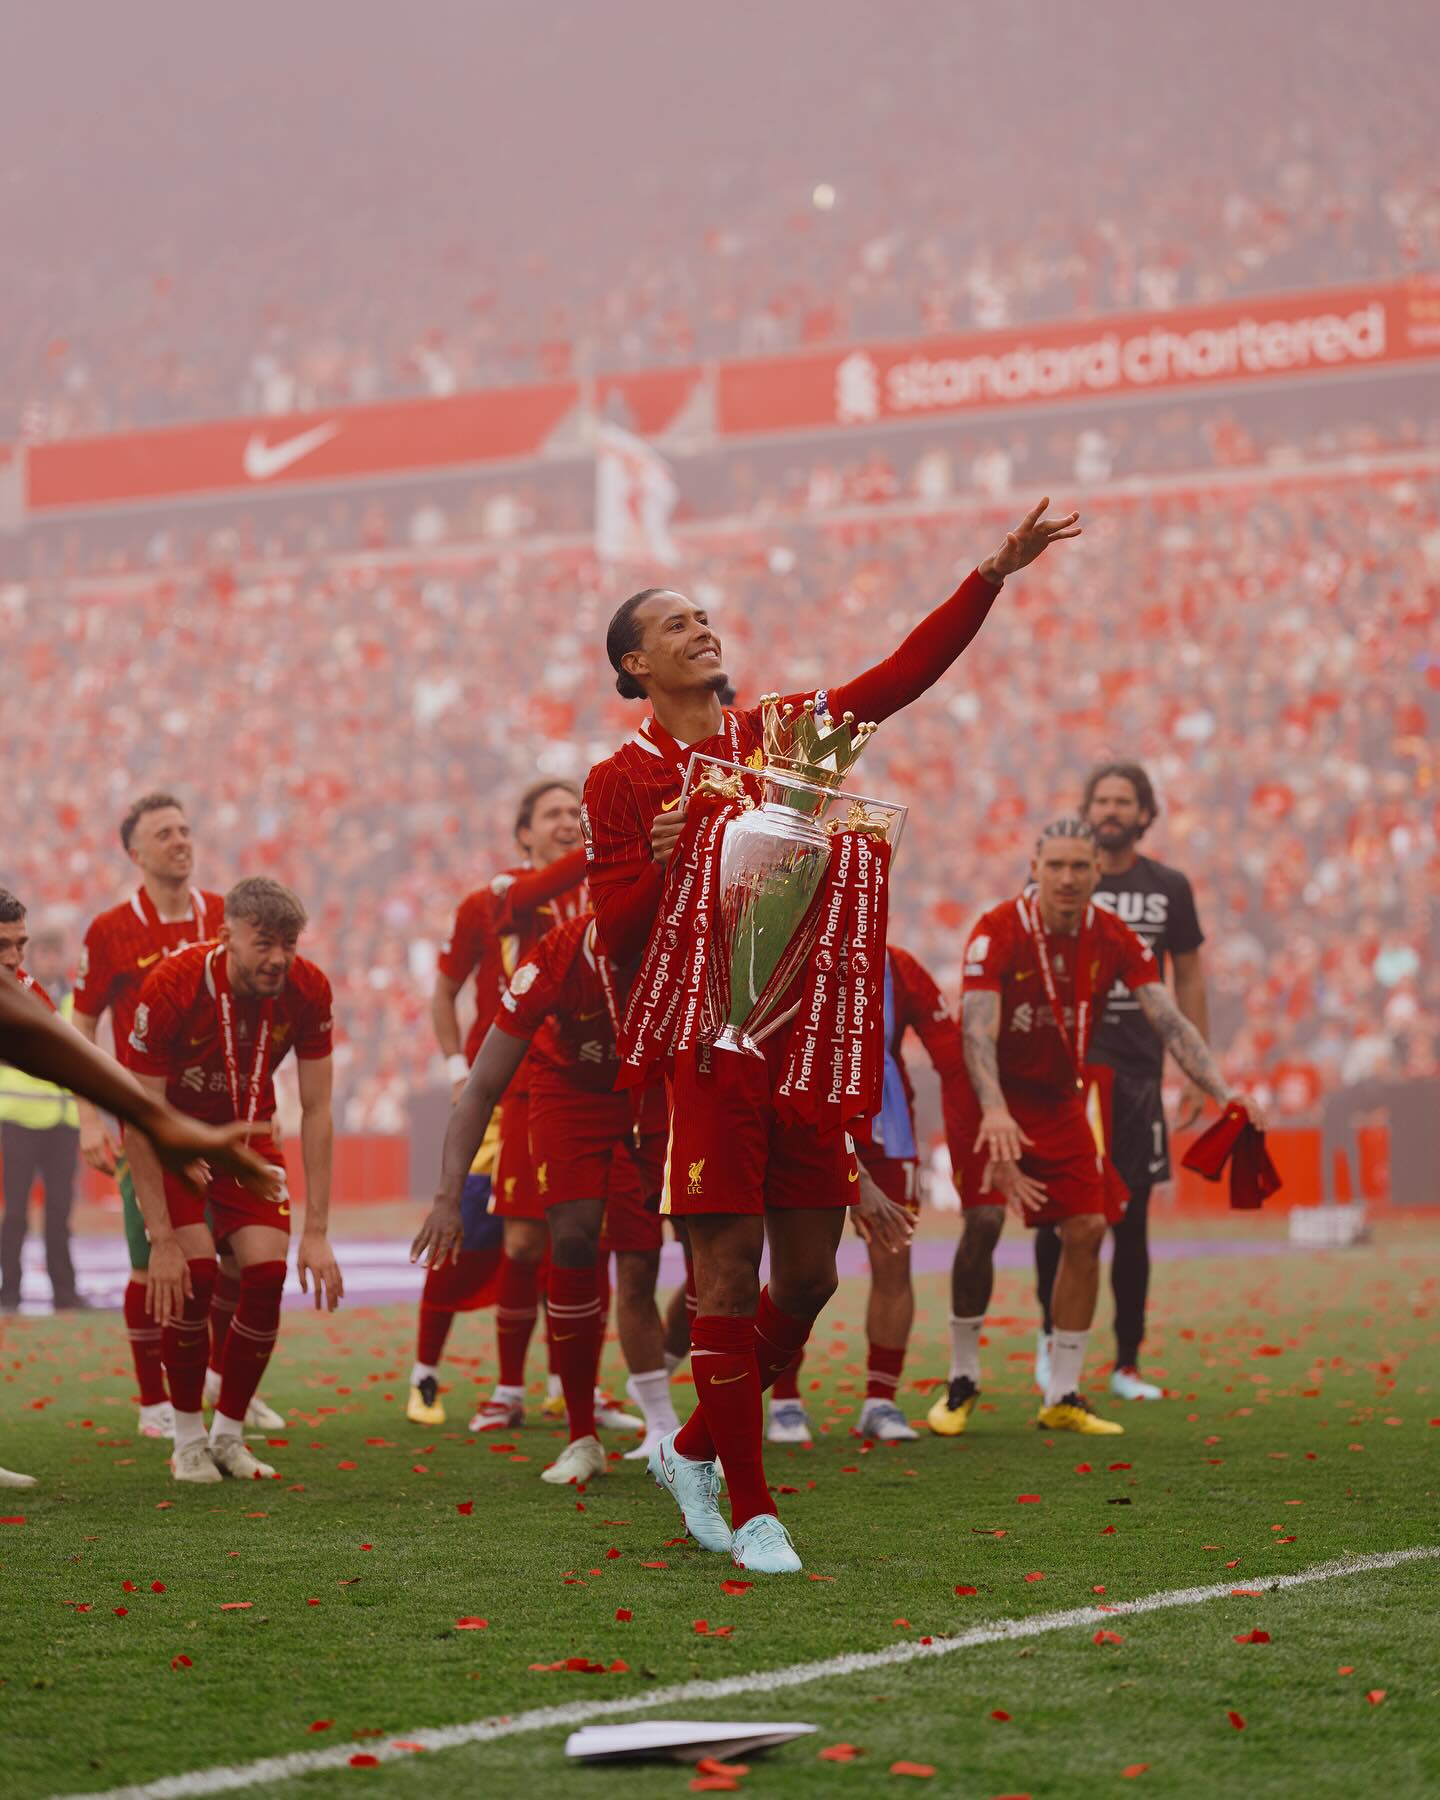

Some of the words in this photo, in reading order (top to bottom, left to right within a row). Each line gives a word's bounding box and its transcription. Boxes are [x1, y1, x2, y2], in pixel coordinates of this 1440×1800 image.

[887, 332, 1121, 411] standard
[1123, 302, 1386, 384] chartered
[704, 804, 733, 852] League
[697, 855, 712, 910] Premier
[854, 838, 872, 889] League
[666, 872, 695, 927] Premier
[819, 890, 843, 947] Premier
[852, 891, 868, 948] Premier
[643, 952, 671, 1008] League
[678, 996, 697, 1051] Premier
[688, 937, 706, 993] League
[804, 973, 827, 1031] League
[849, 977, 868, 1035] League
[653, 986, 682, 1041] Premier
[795, 1033, 817, 1091] Premier
[827, 1046, 844, 1104] Premier
[845, 1038, 862, 1096] Premier
